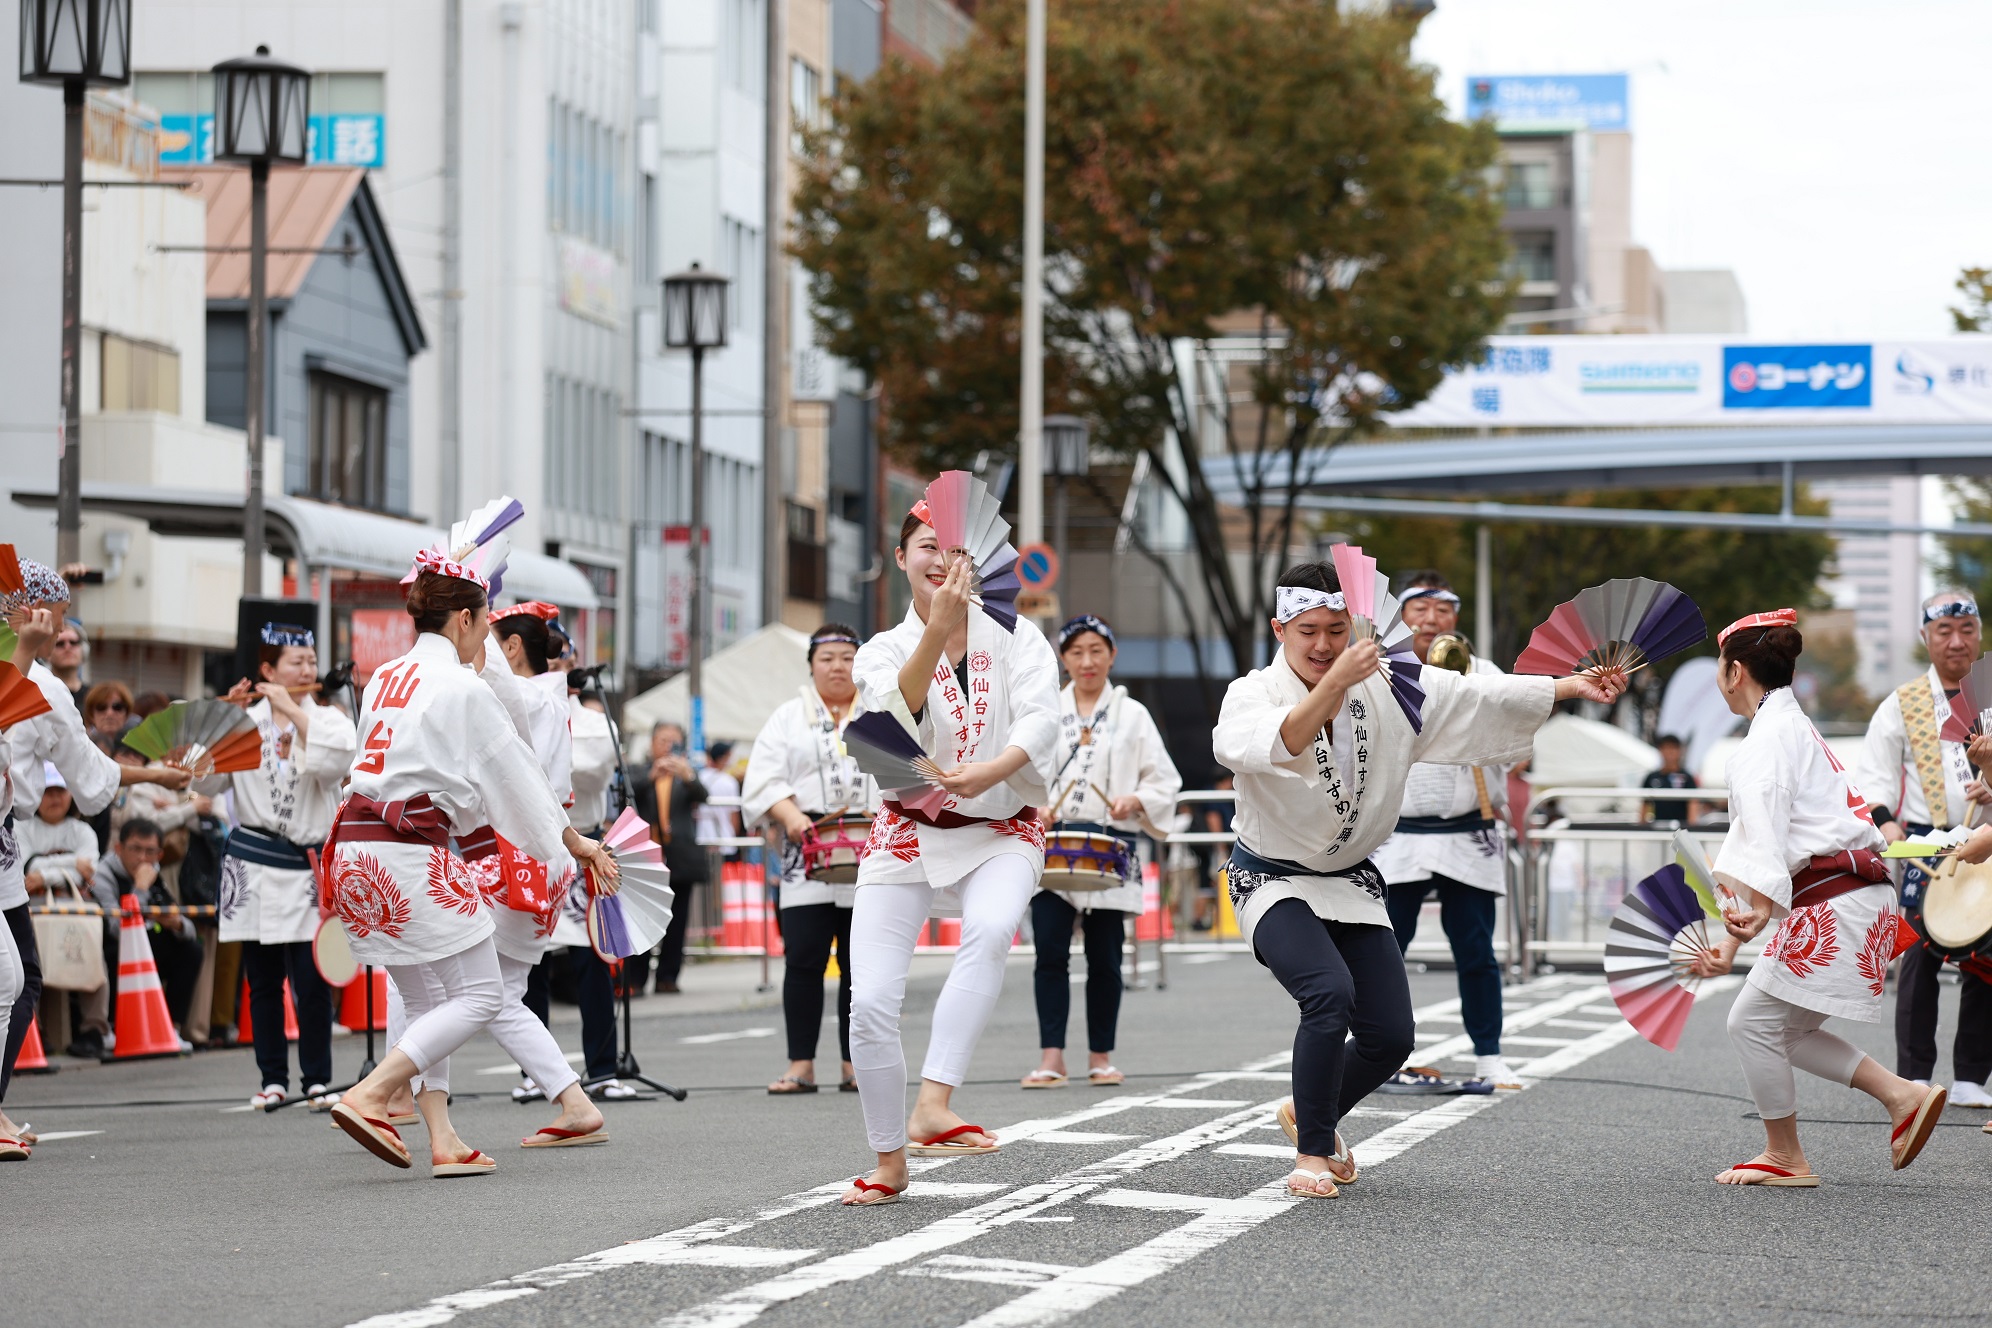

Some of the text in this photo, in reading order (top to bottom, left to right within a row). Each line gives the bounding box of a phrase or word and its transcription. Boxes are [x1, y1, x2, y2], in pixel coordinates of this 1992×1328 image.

[1757, 362, 1866, 391] コーナン
[353, 661, 421, 775] 仙台
[1327, 724, 1369, 856] 仙台すずめ踊り
